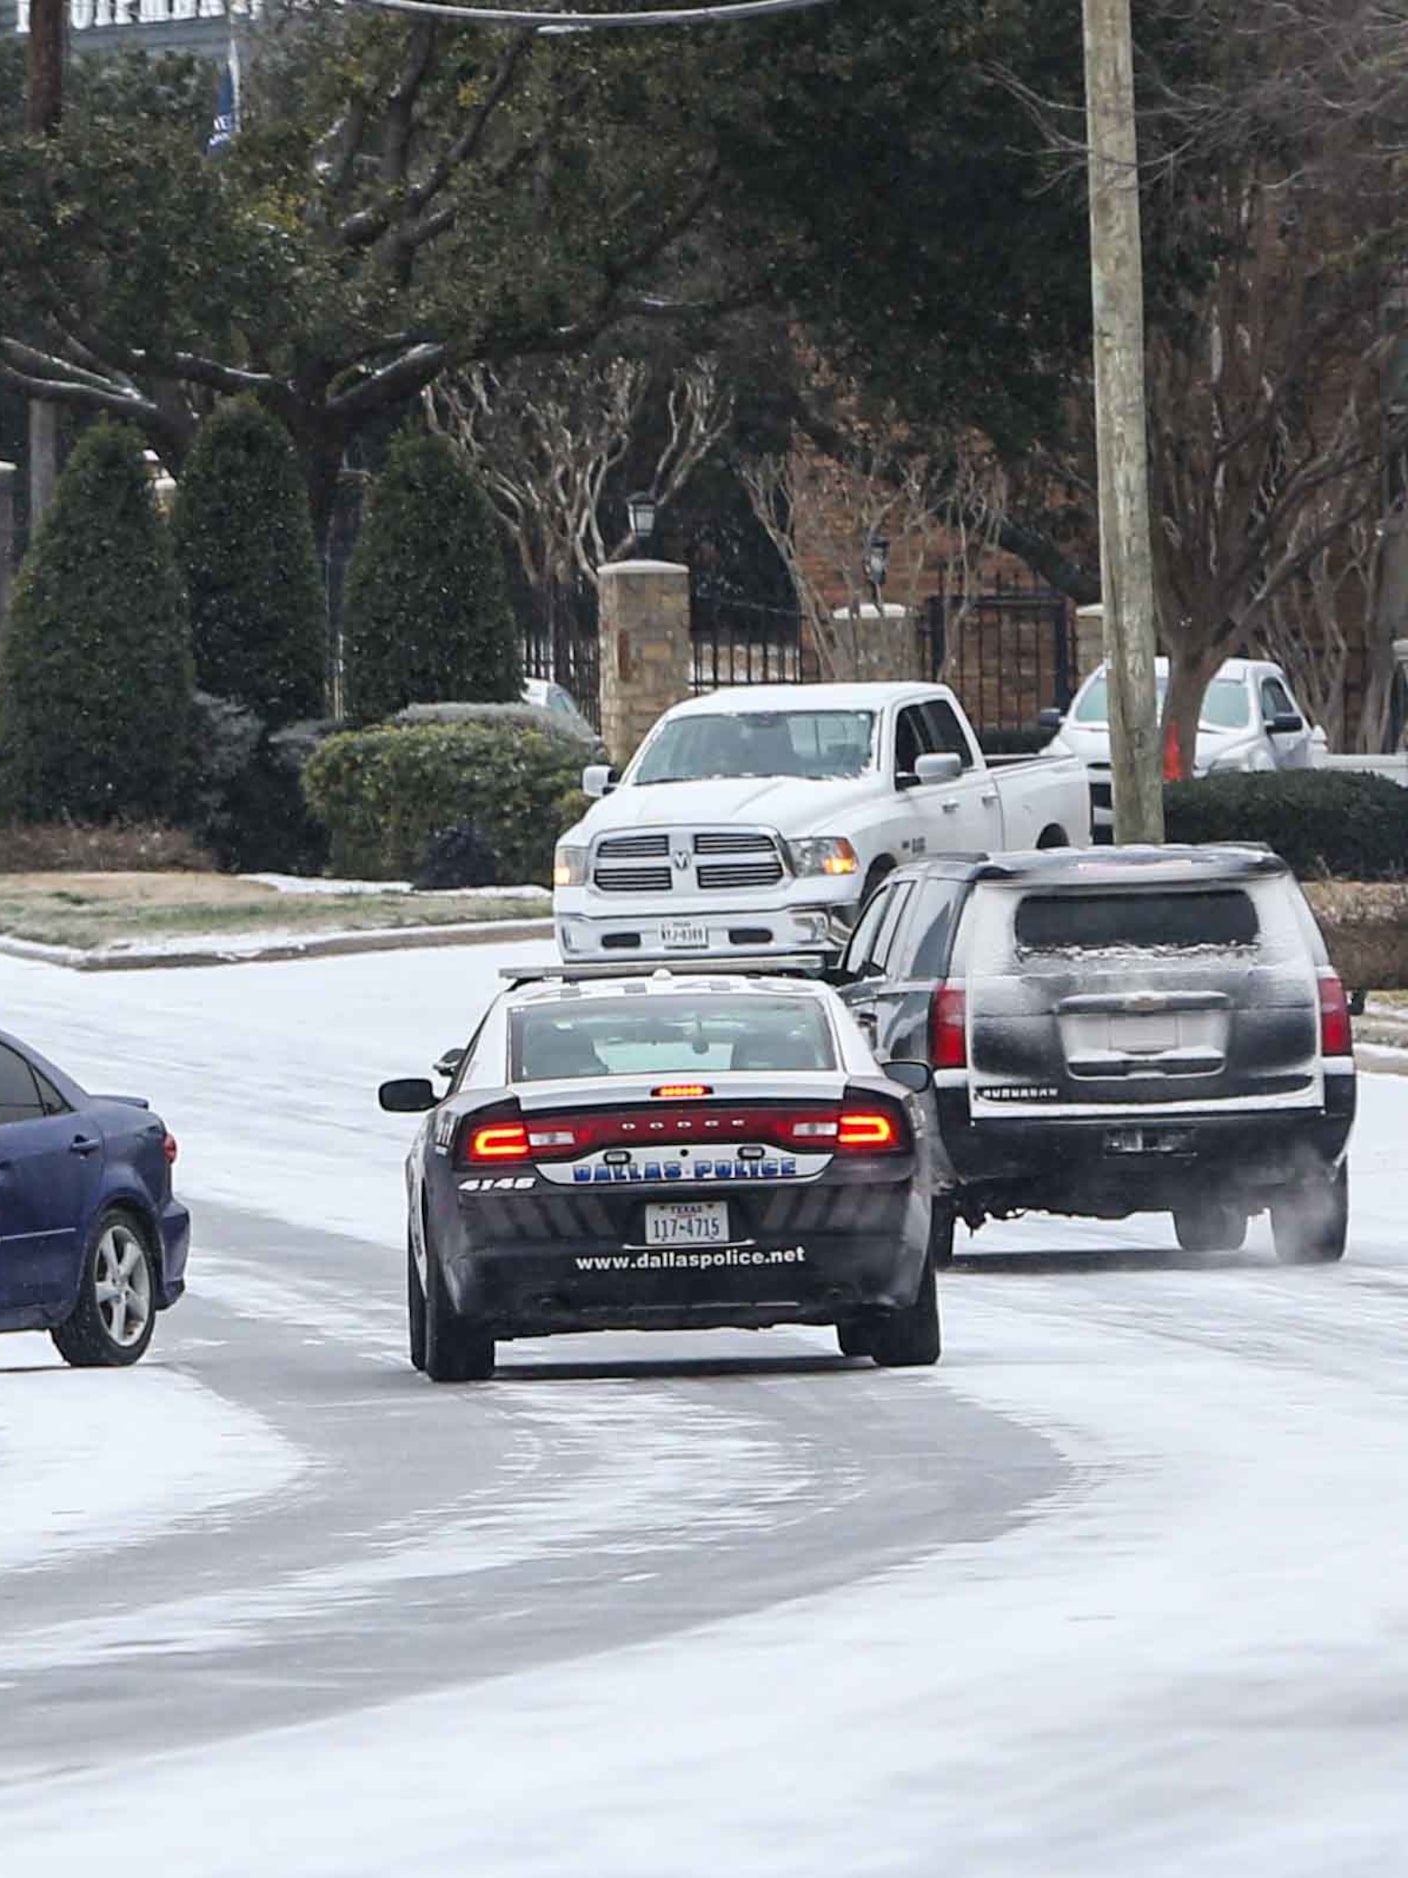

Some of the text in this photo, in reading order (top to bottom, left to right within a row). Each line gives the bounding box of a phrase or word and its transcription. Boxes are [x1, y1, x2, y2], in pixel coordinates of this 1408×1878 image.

[621, 1119, 745, 1130] DODGE
[572, 1157, 797, 1182] DALLAS POLICE
[670, 1204, 703, 1214] TEXAS
[654, 1217, 720, 1239] 117-4715
[575, 1246, 806, 1271] www.dallaspolice.net
